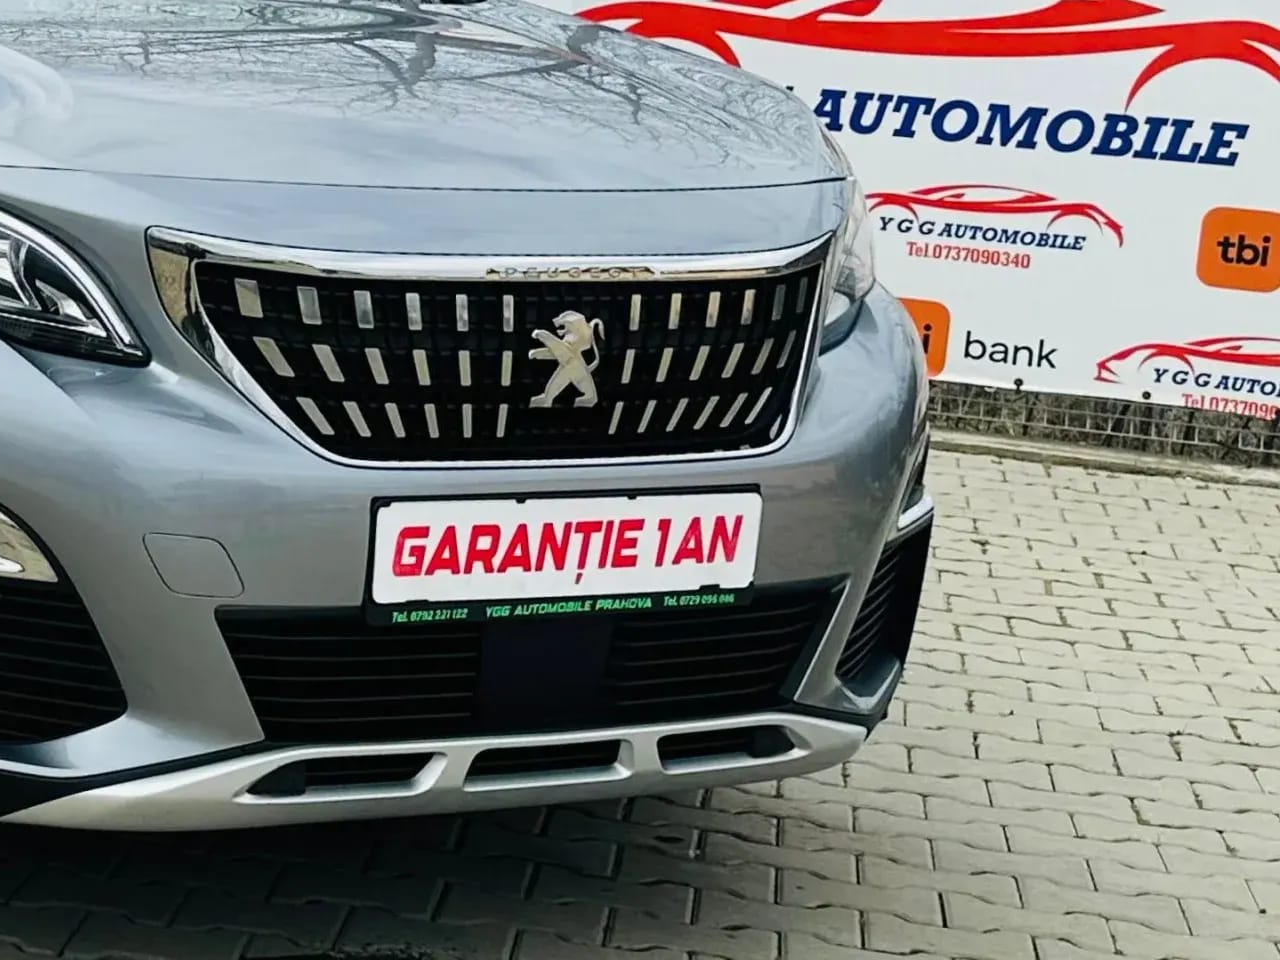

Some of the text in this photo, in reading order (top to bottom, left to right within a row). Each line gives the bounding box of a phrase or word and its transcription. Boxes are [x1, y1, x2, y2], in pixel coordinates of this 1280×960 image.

[813, 87, 1250, 167] AUTOMOBILE
[938, 223, 1086, 251] AUTOMOBILE
[1217, 234, 1271, 267] tbi
[963, 330, 1059, 369] bank
[485, 605, 511, 619] YGG
[514, 600, 593, 617] AUTOMOBILE
[595, 597, 653, 611] PRAHOVA
